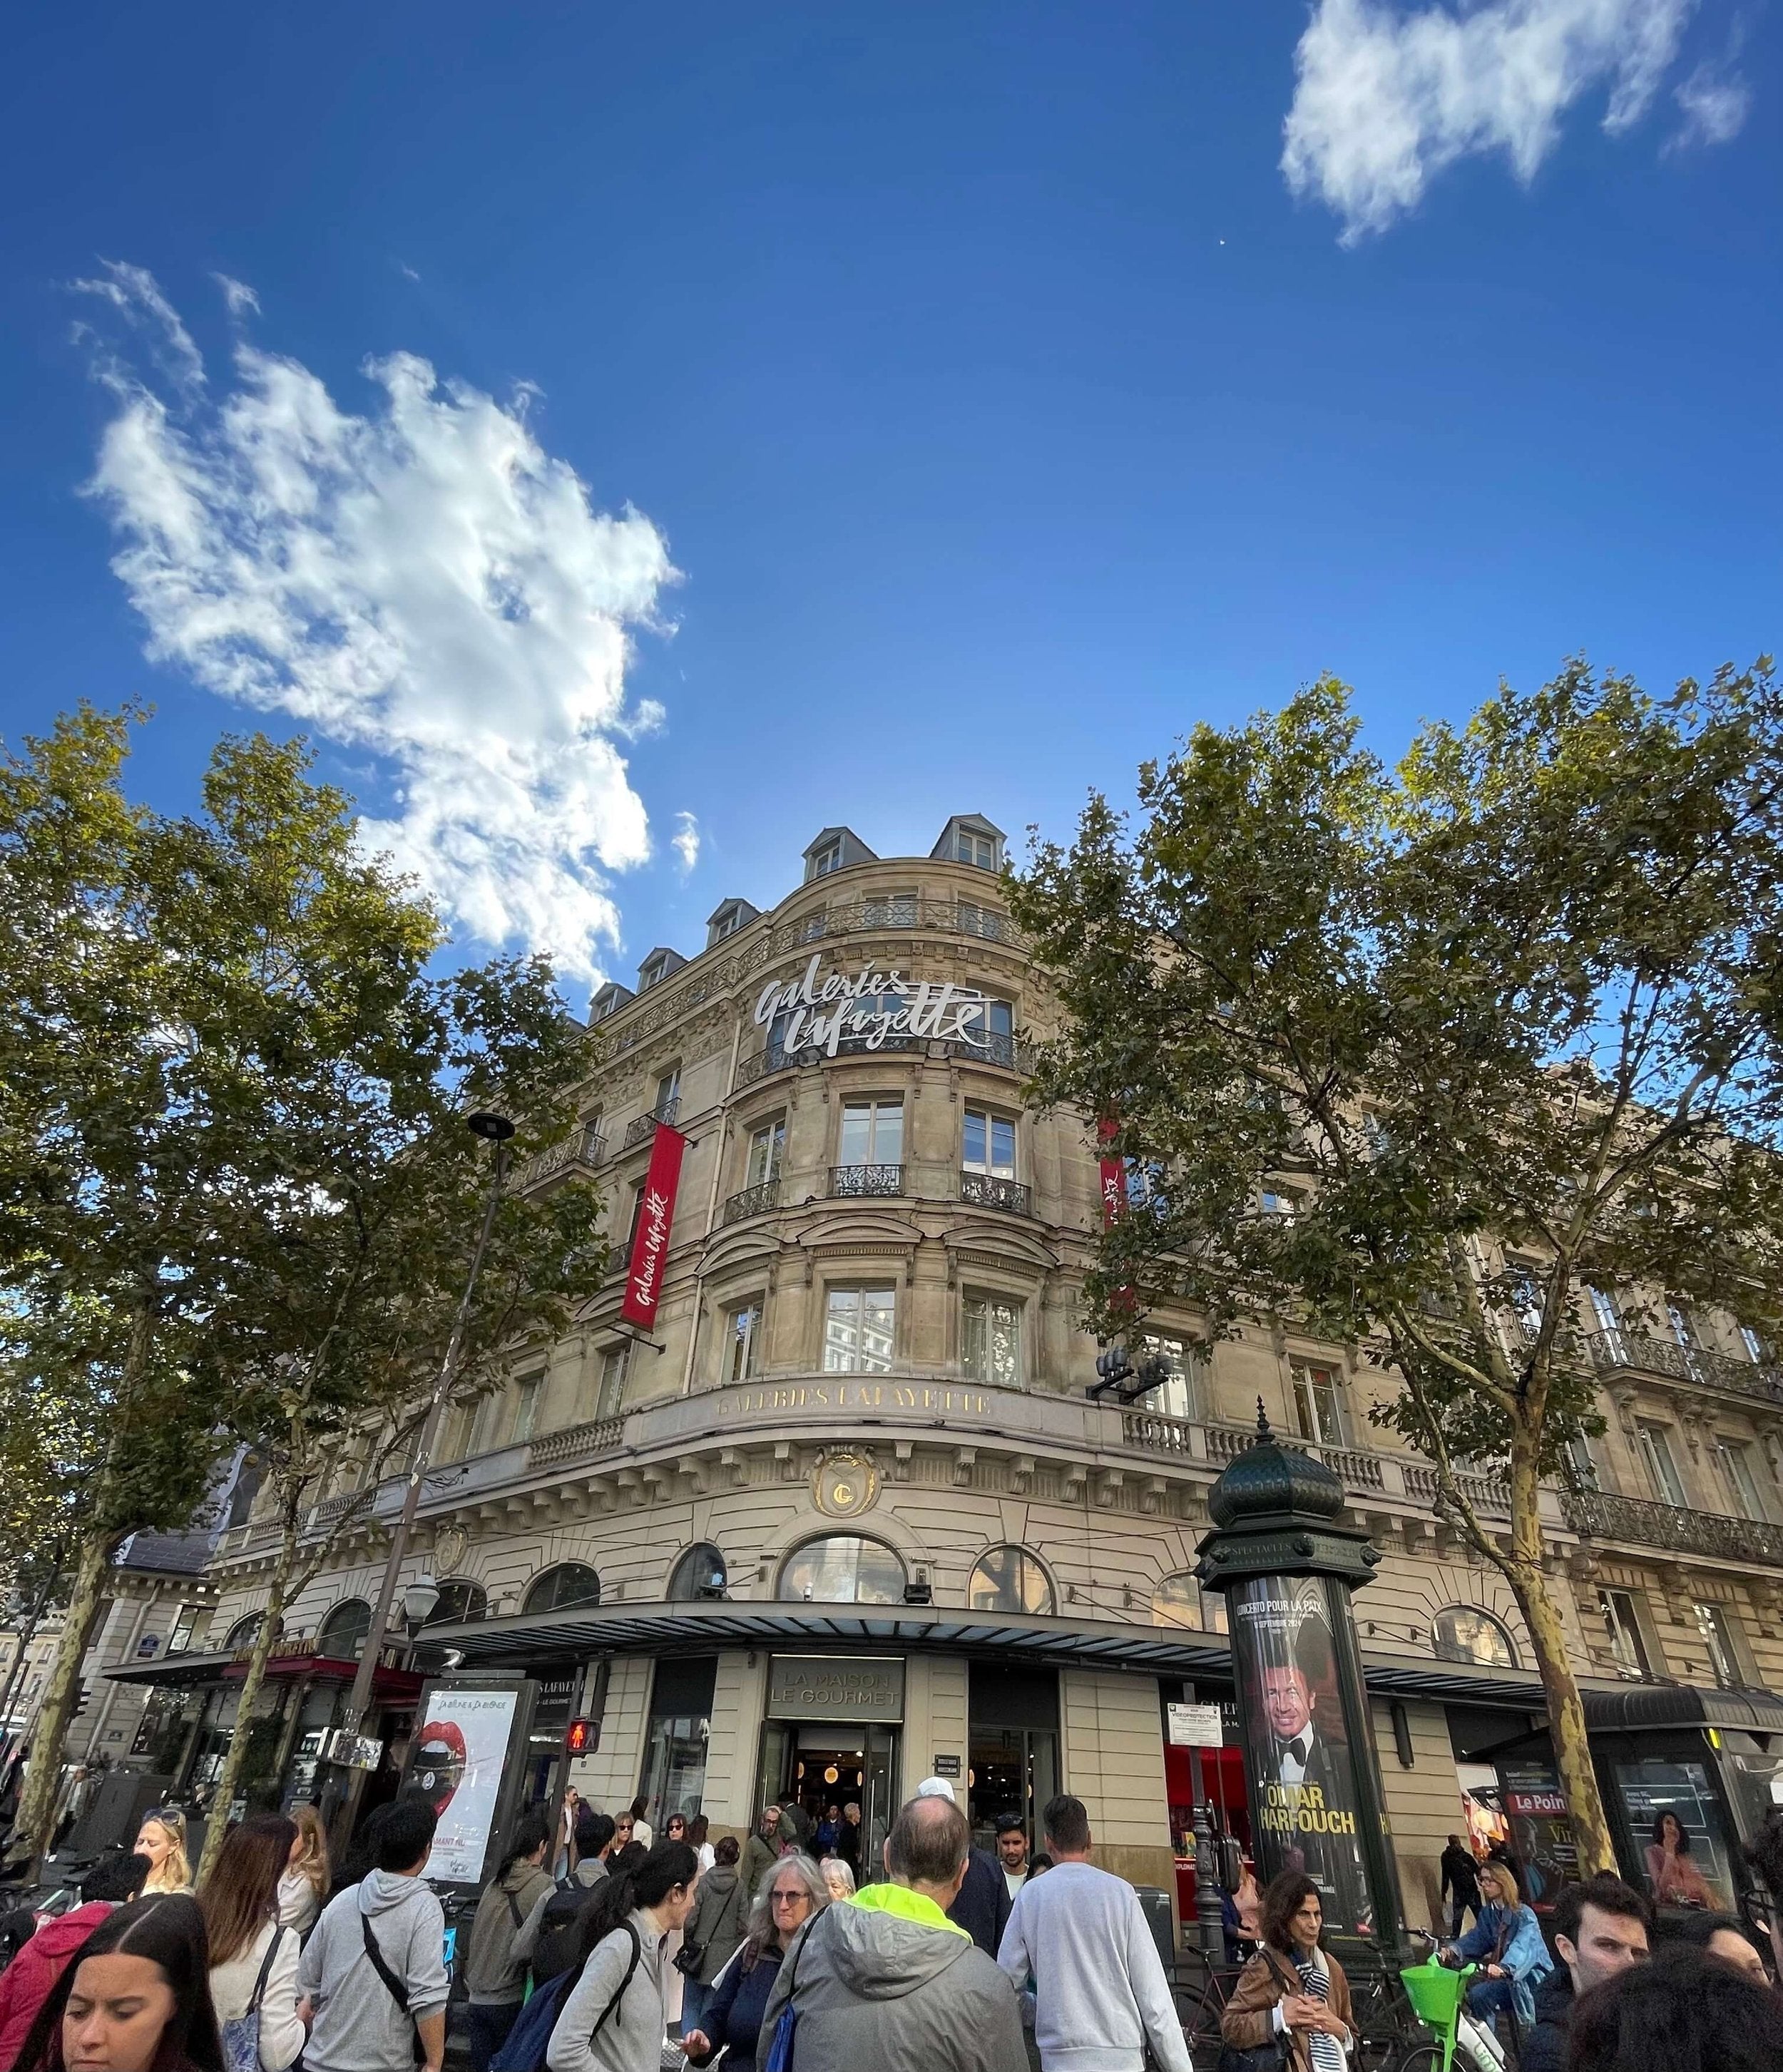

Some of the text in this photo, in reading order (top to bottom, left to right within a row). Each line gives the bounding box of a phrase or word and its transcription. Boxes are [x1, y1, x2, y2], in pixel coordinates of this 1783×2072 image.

[785, 982, 999, 1057] Lafayette
[717, 1386, 991, 1416] GALERIES LAFAYETTE
[1237, 1599, 1322, 1616] CONCERTO POUR LA PAIX
[784, 1672, 890, 1688] LA MAISON
[771, 1689, 899, 1706] LE GOURMET
[1267, 1785, 1324, 1809] OMAR
[1515, 1793, 1565, 1810] Le Poin
[1260, 1806, 1355, 1835] HARFOUCH
[1474, 2041, 1498, 2072] Lim
